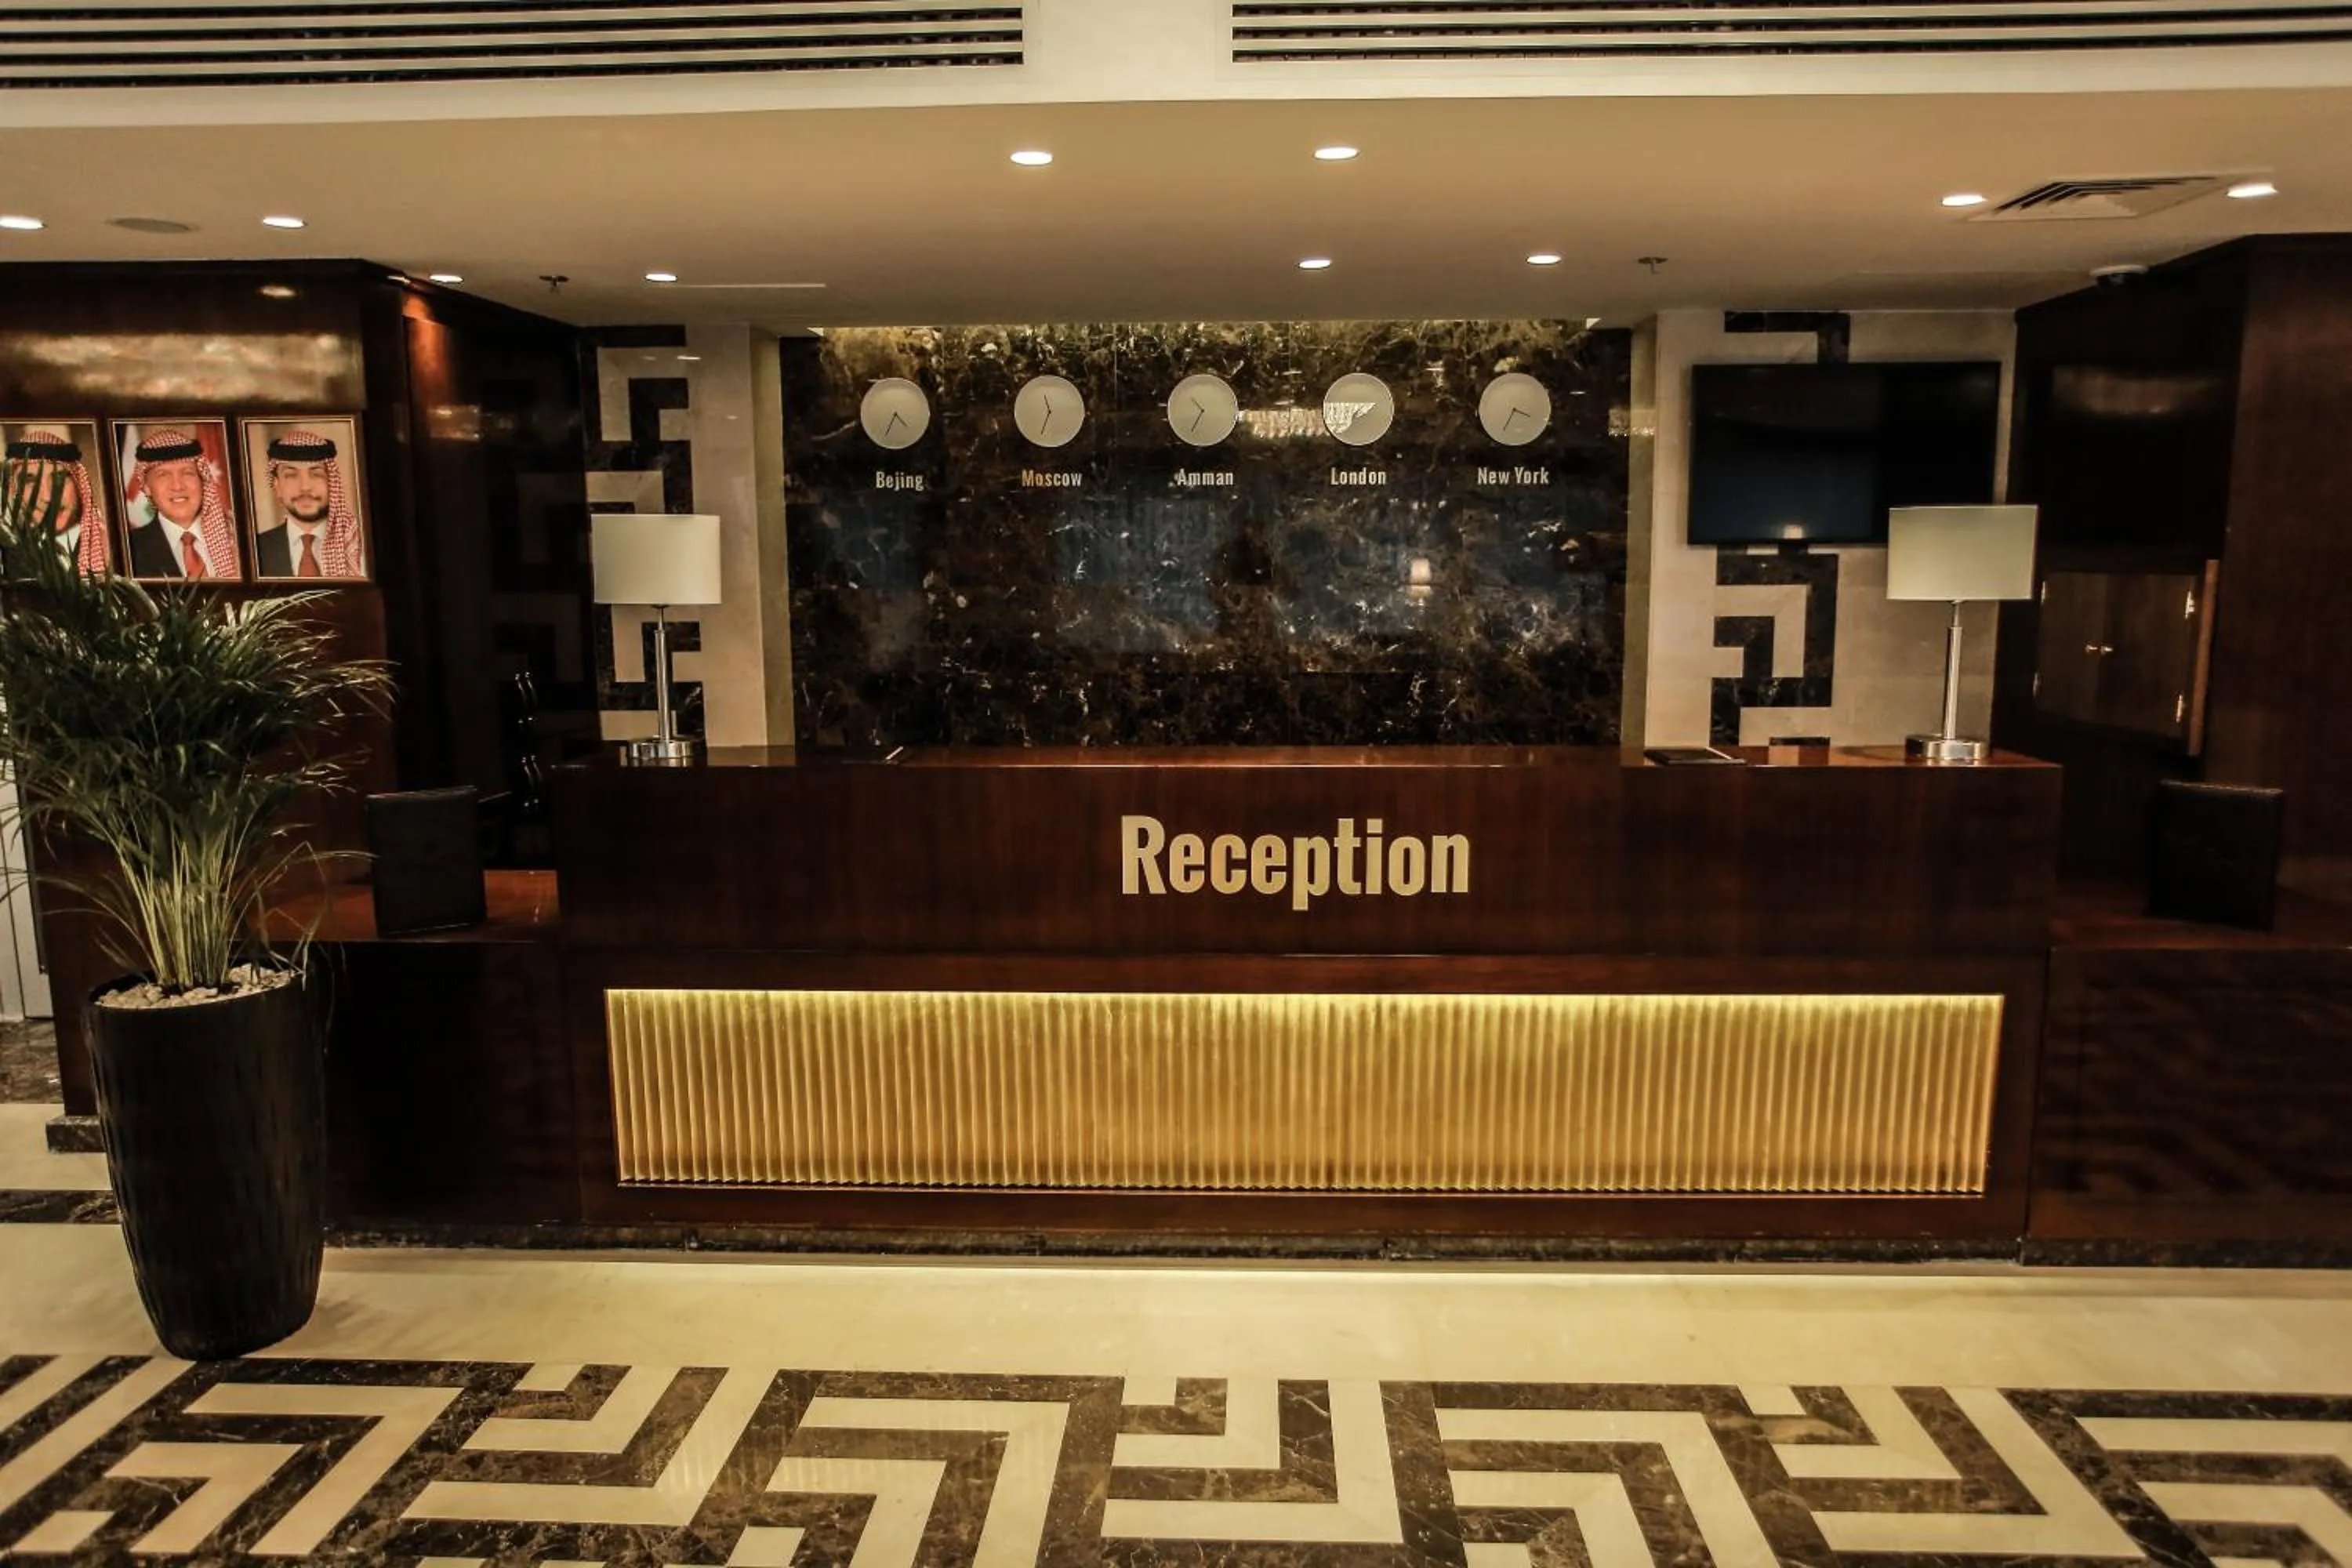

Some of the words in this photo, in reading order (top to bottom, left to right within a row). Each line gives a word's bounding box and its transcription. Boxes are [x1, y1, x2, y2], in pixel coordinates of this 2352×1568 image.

[876, 470, 924, 492] Bejing
[1022, 469, 1083, 487] Moscow
[1177, 468, 1233, 486] Amman
[1330, 466, 1386, 485] London
[1477, 466, 1510, 485] New
[1514, 466, 1549, 485] York
[1121, 814, 1470, 911] Reception
